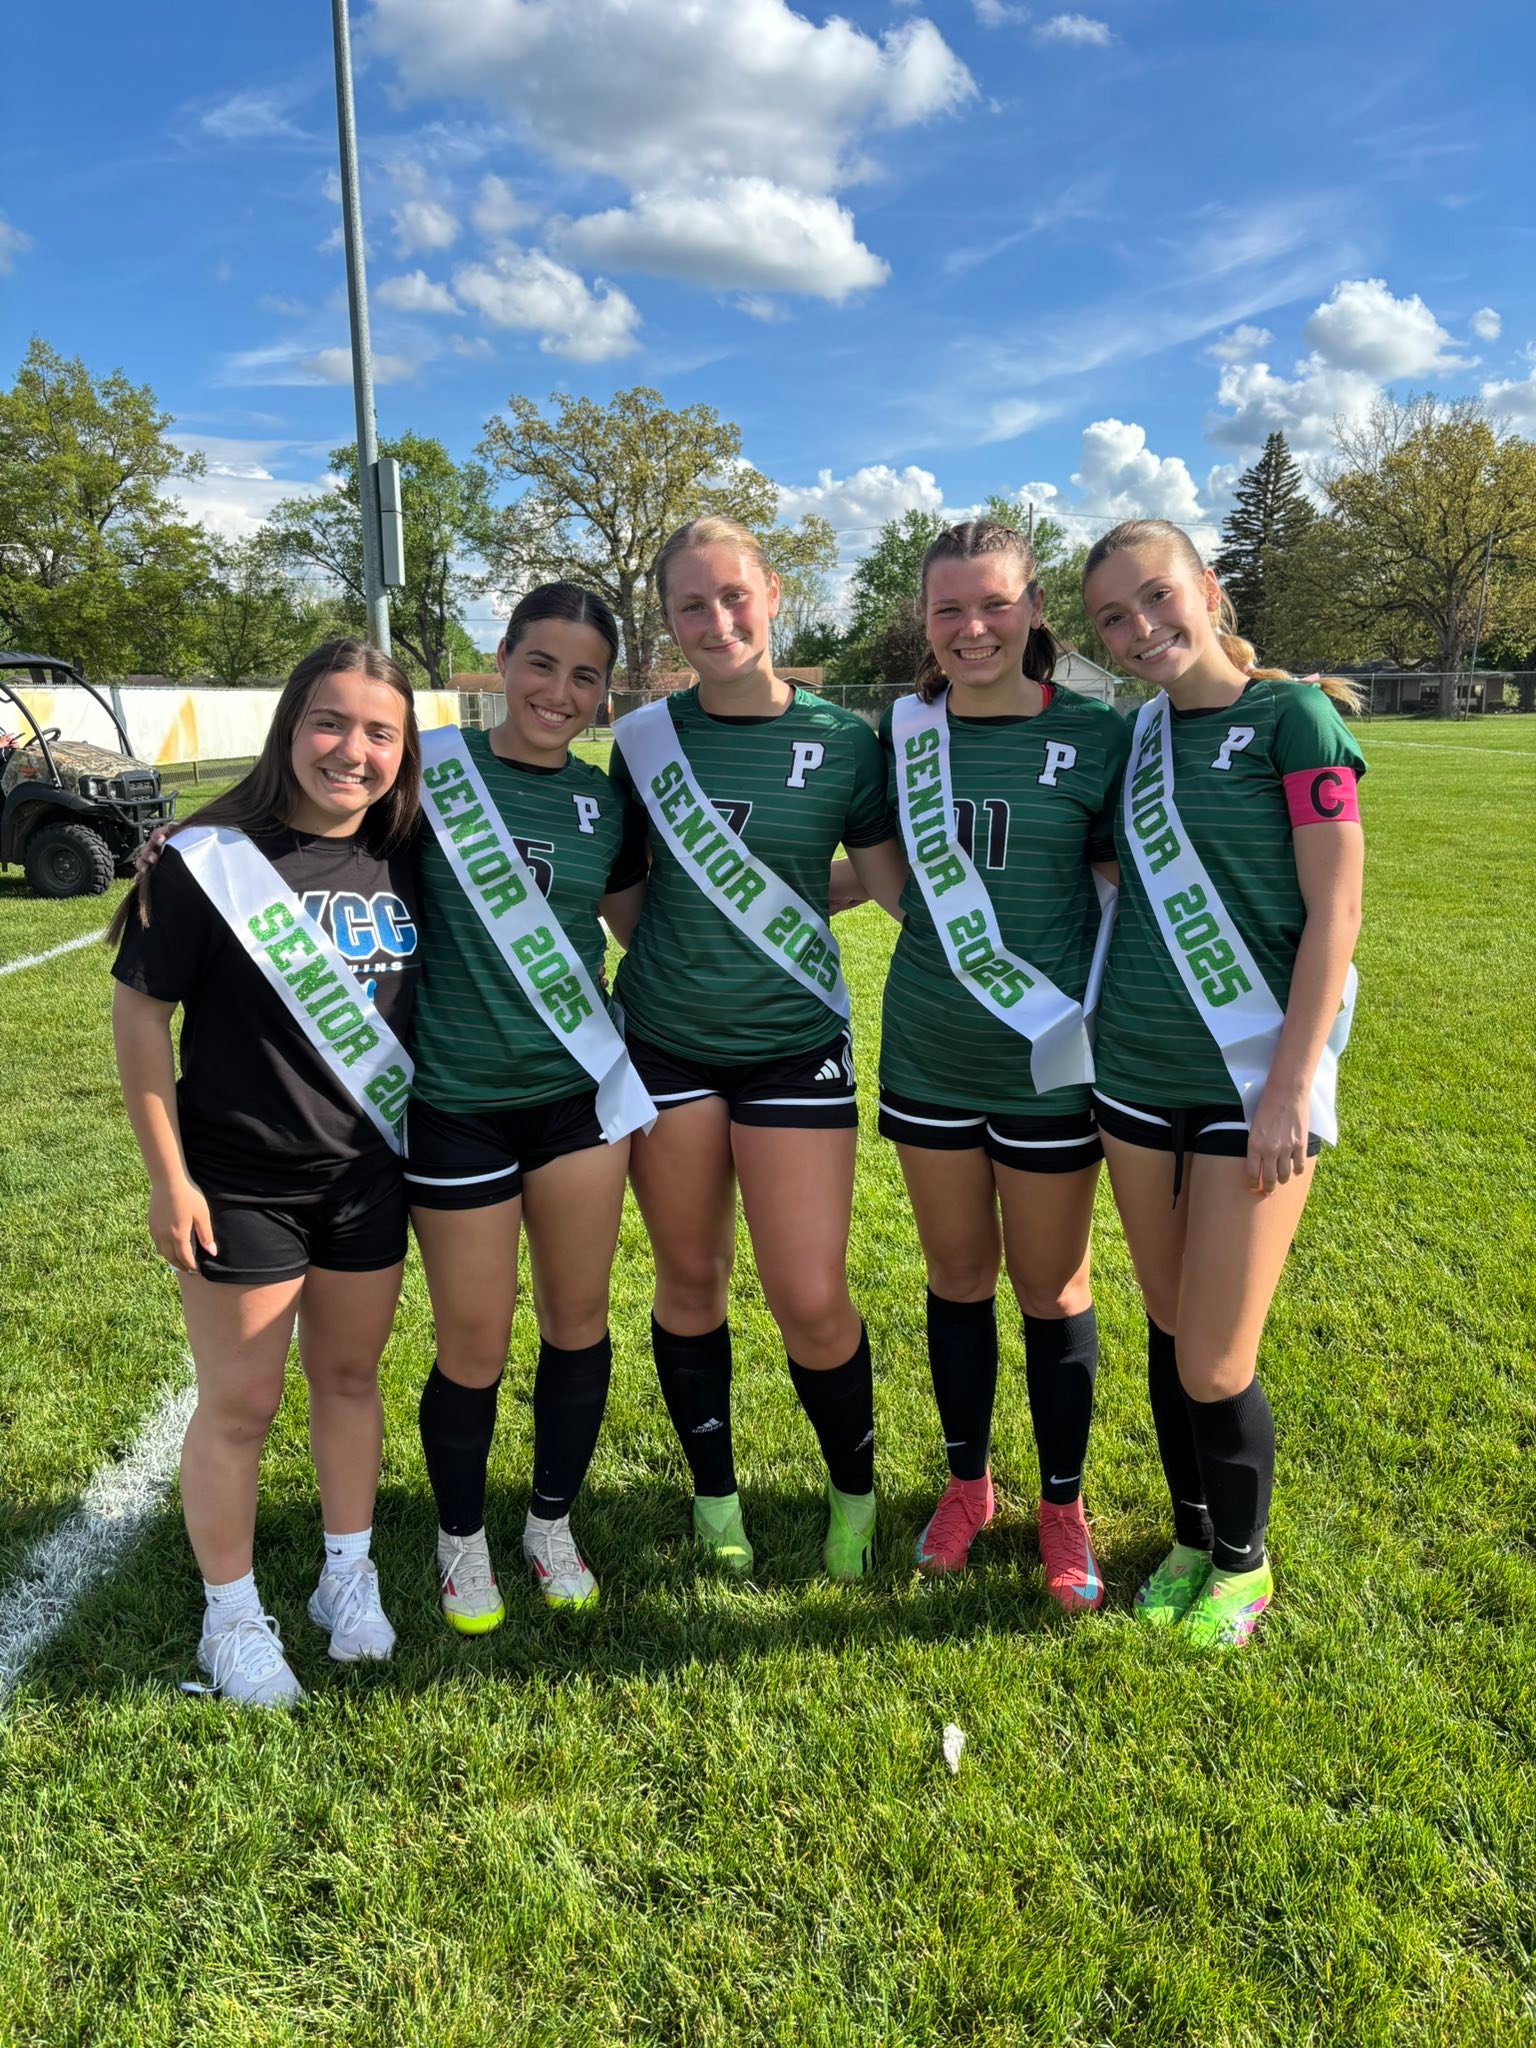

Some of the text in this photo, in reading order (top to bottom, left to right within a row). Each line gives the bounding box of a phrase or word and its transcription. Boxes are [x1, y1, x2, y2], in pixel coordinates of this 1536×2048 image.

[785, 740, 826, 789] P
[1037, 739, 1078, 788] P
[1209, 725, 1256, 771] P
[571, 793, 603, 835] P
[1310, 771, 1345, 818] C
[650, 760, 840, 993] SENIOR 2025
[904, 727, 1036, 1009] SENIOR 2025
[1131, 709, 1254, 1008] SENIOR 2025
[300, 890, 418, 960] CC
[421, 757, 594, 1034] SENIOR 2025
[247, 901, 380, 1069] SENIOR
